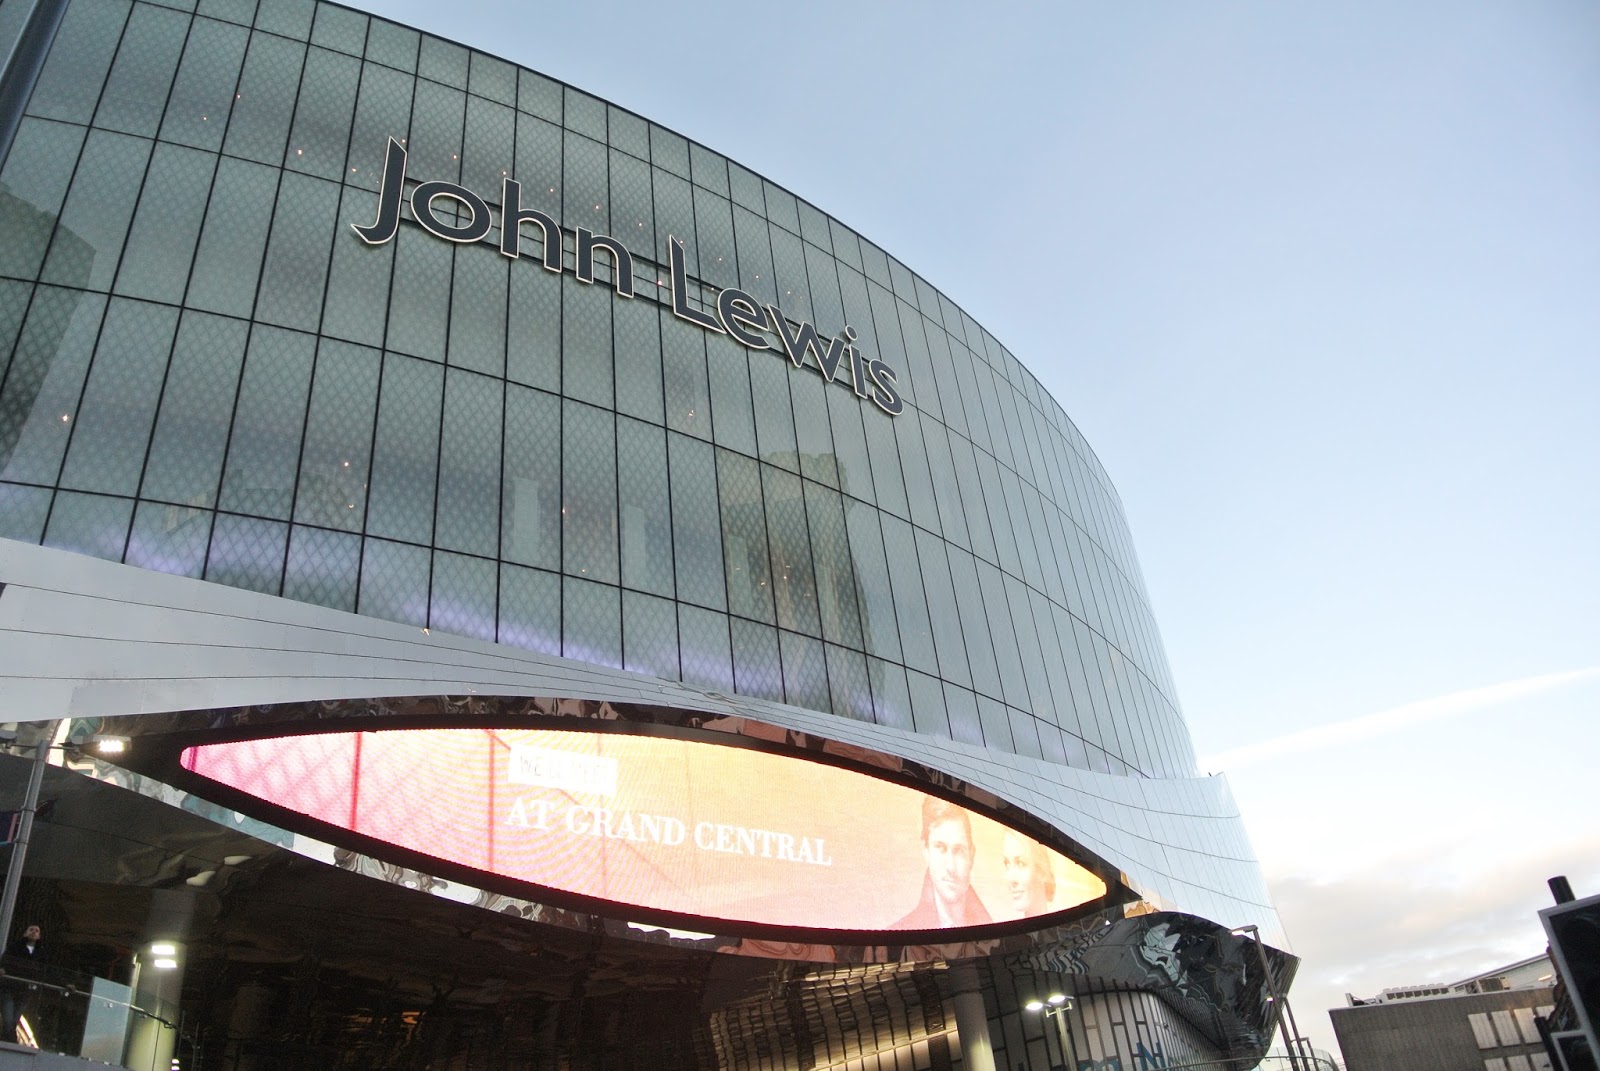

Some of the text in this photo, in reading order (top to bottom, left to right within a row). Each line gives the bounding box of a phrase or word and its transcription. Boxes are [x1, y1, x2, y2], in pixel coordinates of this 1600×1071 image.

[350, 136, 904, 416] John Lewis
[504, 796, 832, 866] AT GRAND CENTRAL
